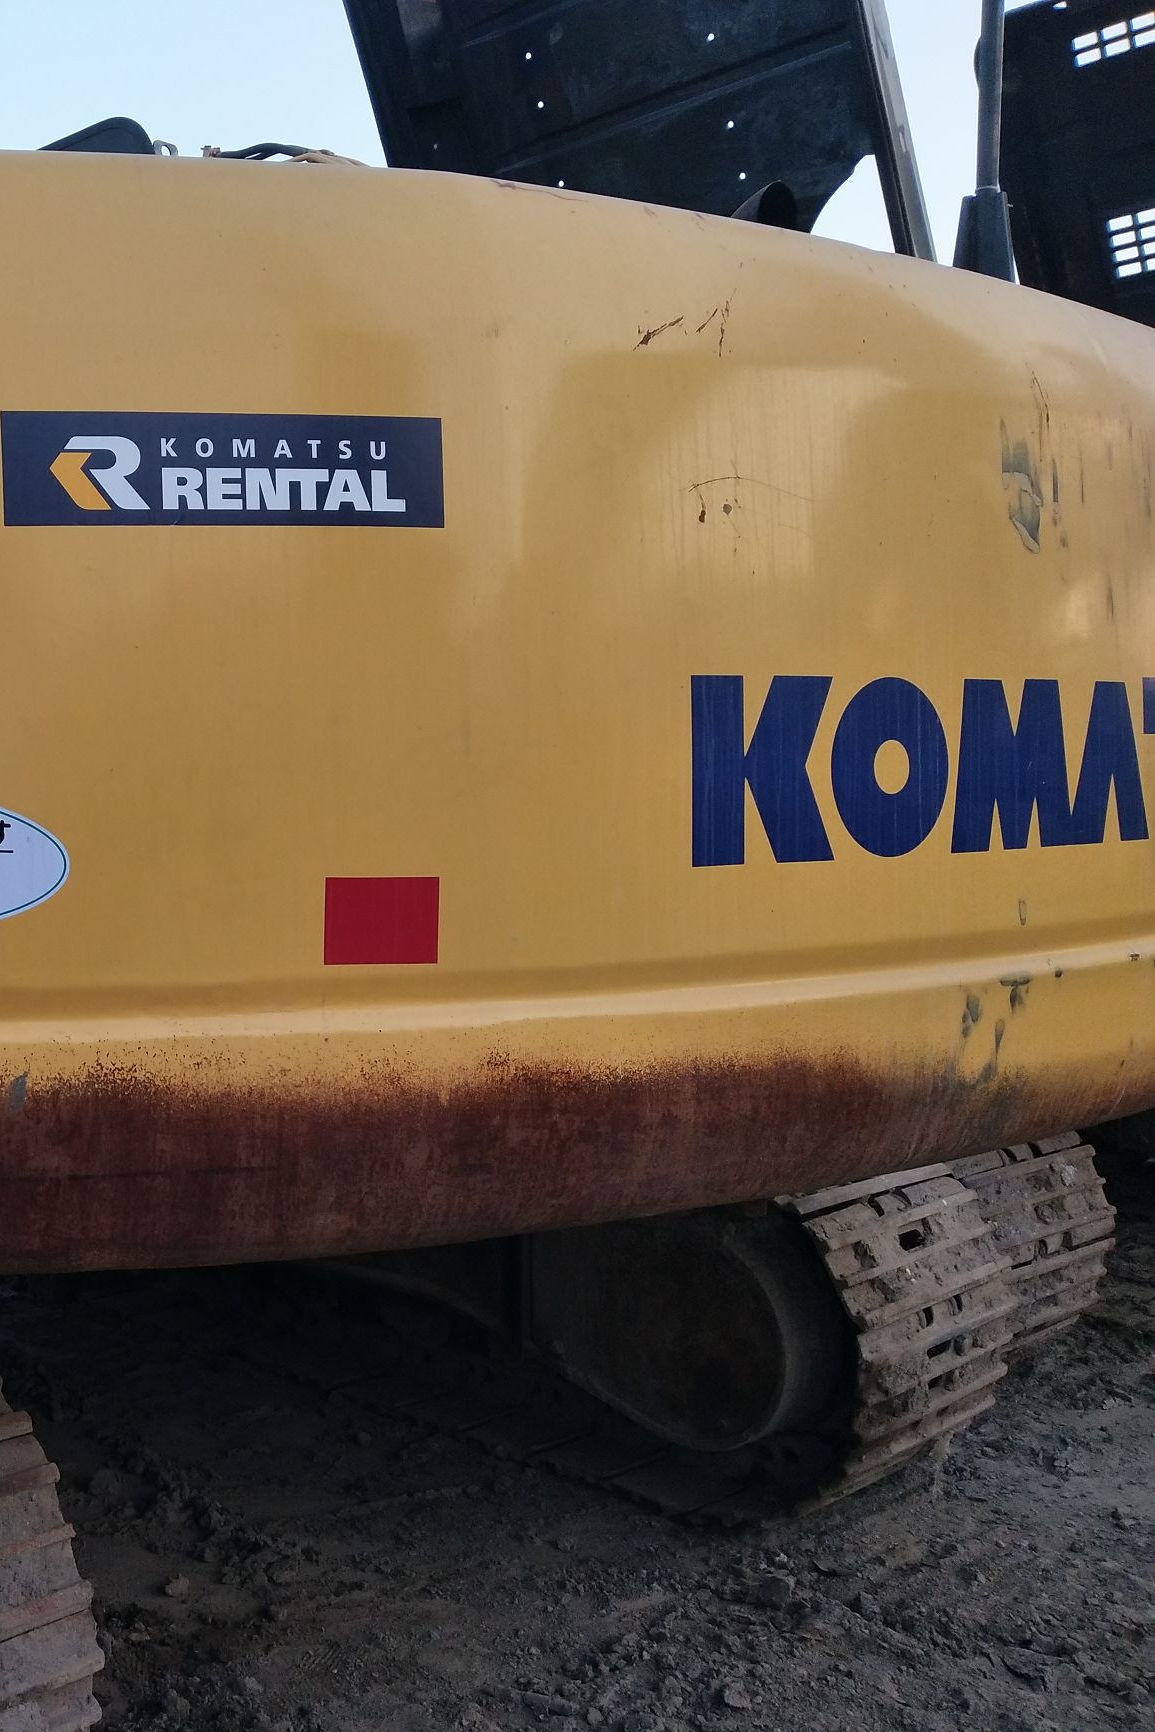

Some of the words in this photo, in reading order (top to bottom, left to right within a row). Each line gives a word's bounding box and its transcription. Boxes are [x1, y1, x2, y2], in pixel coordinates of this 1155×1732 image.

[161, 437, 387, 460] KOMATSU
[161, 467, 406, 513] RENTAL
[690, 674, 1155, 868] KOMA
